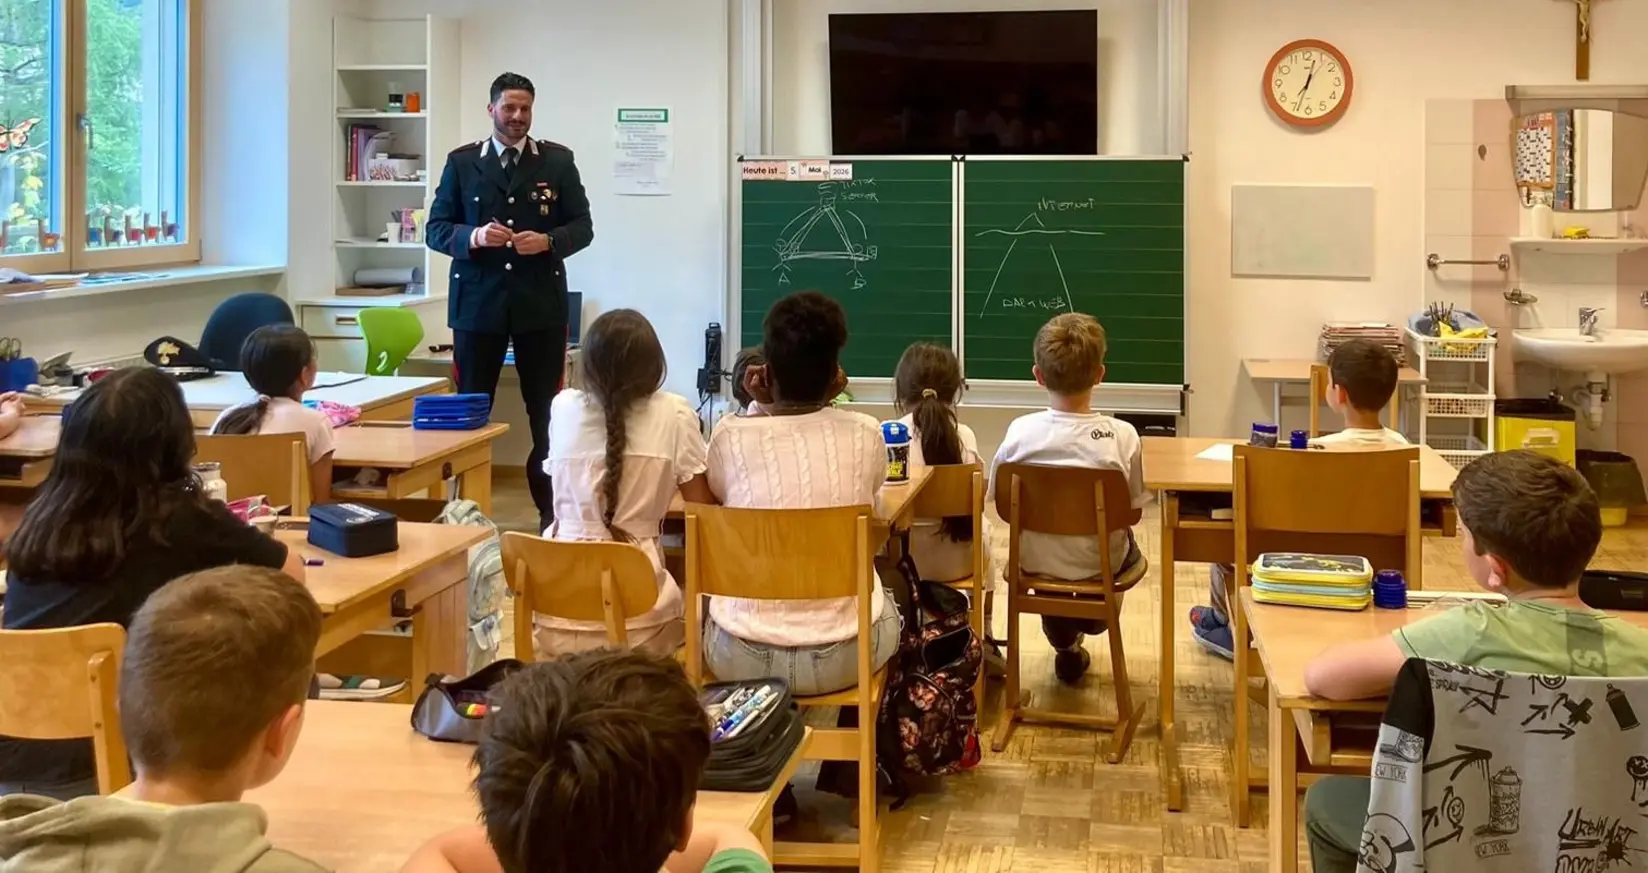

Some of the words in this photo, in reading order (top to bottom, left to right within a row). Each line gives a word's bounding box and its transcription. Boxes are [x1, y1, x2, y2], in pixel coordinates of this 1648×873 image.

[1290, 55, 1298, 65] 11
[1302, 50, 1312, 61] 12
[1278, 64, 1291, 75] 10
[1327, 62, 1336, 73] 2
[1274, 78, 1283, 89] 9
[1333, 76, 1341, 87] 3
[1279, 92, 1287, 103] 8
[1329, 91, 1336, 100] 4
[1291, 101, 1298, 112] 7
[1304, 104, 1313, 116] 6
[1319, 100, 1327, 111] 5
[743, 166, 766, 174] Heute
[768, 166, 778, 174] ist
